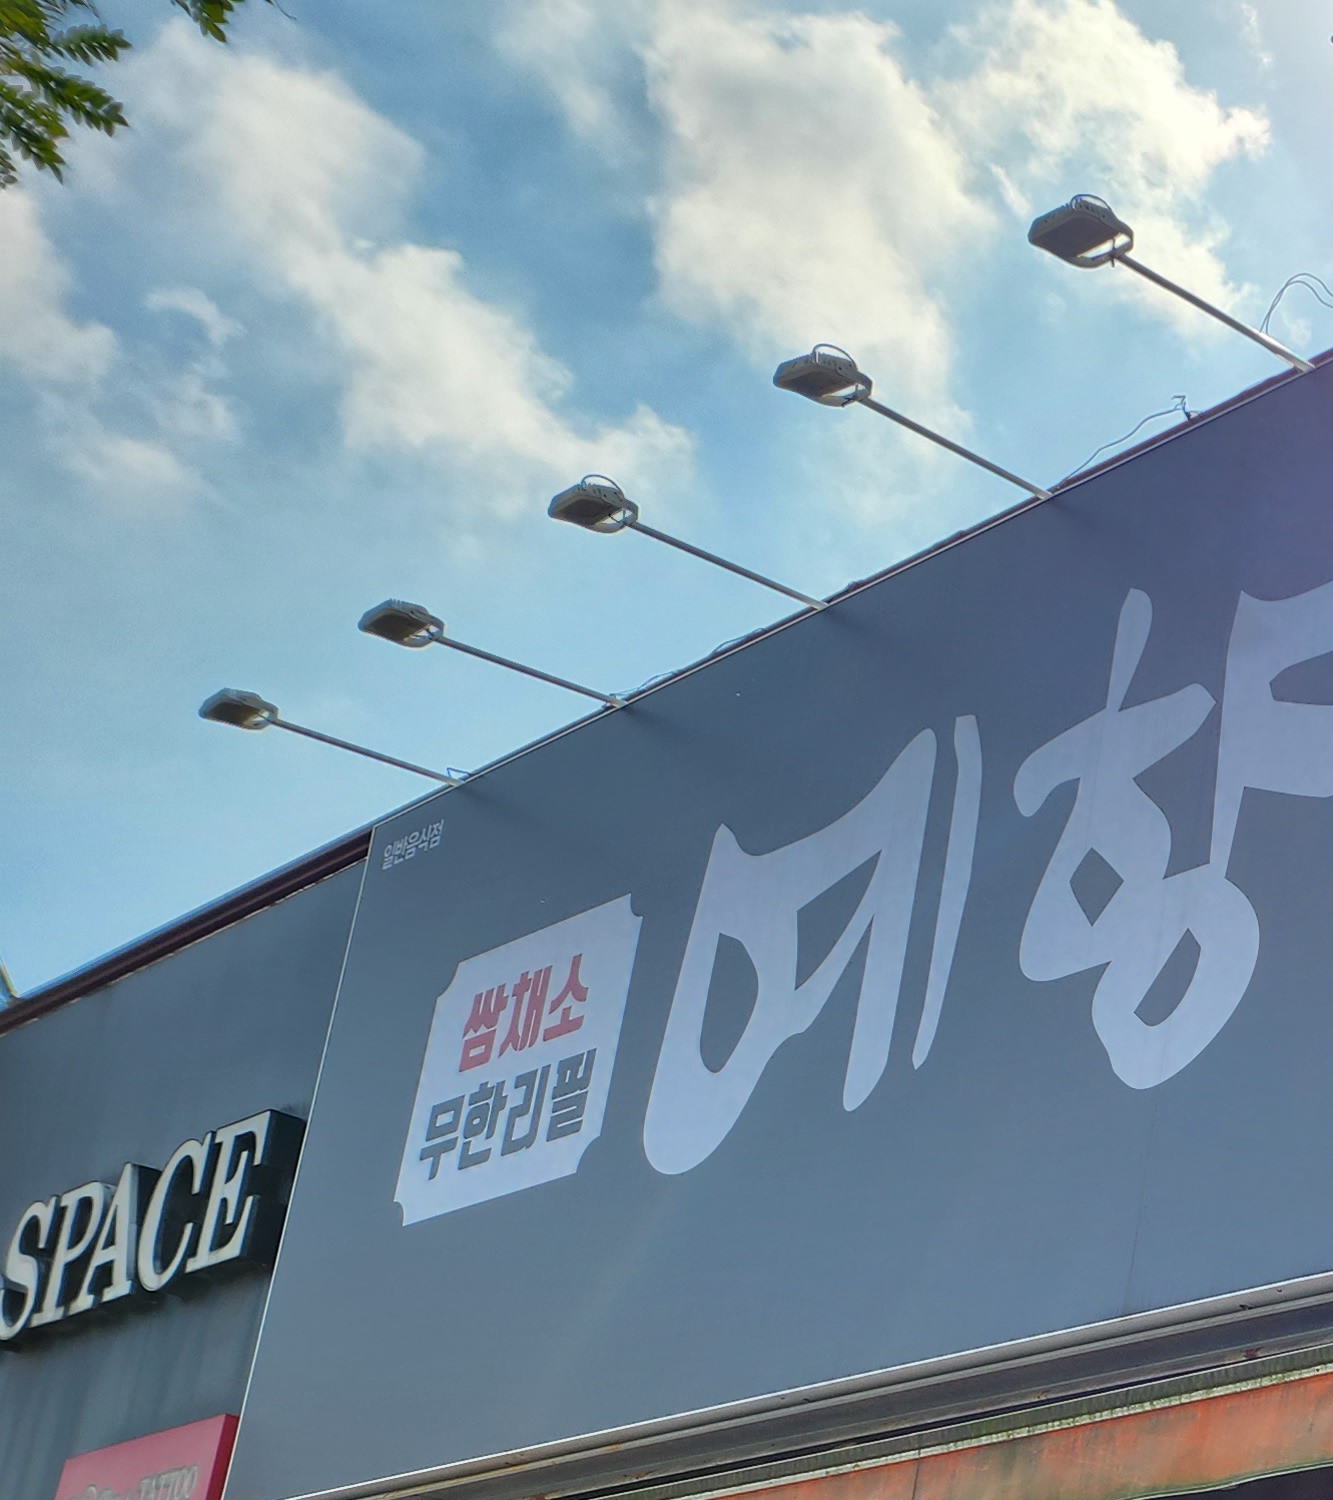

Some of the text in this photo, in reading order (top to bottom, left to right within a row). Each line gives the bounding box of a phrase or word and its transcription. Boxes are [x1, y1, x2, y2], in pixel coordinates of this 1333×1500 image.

[382, 819, 444, 870] 일반음식점
[459, 953, 589, 1072] 쌈채소
[419, 1048, 597, 1181] 무한리필
[0, 1110, 272, 1341] SPACE
